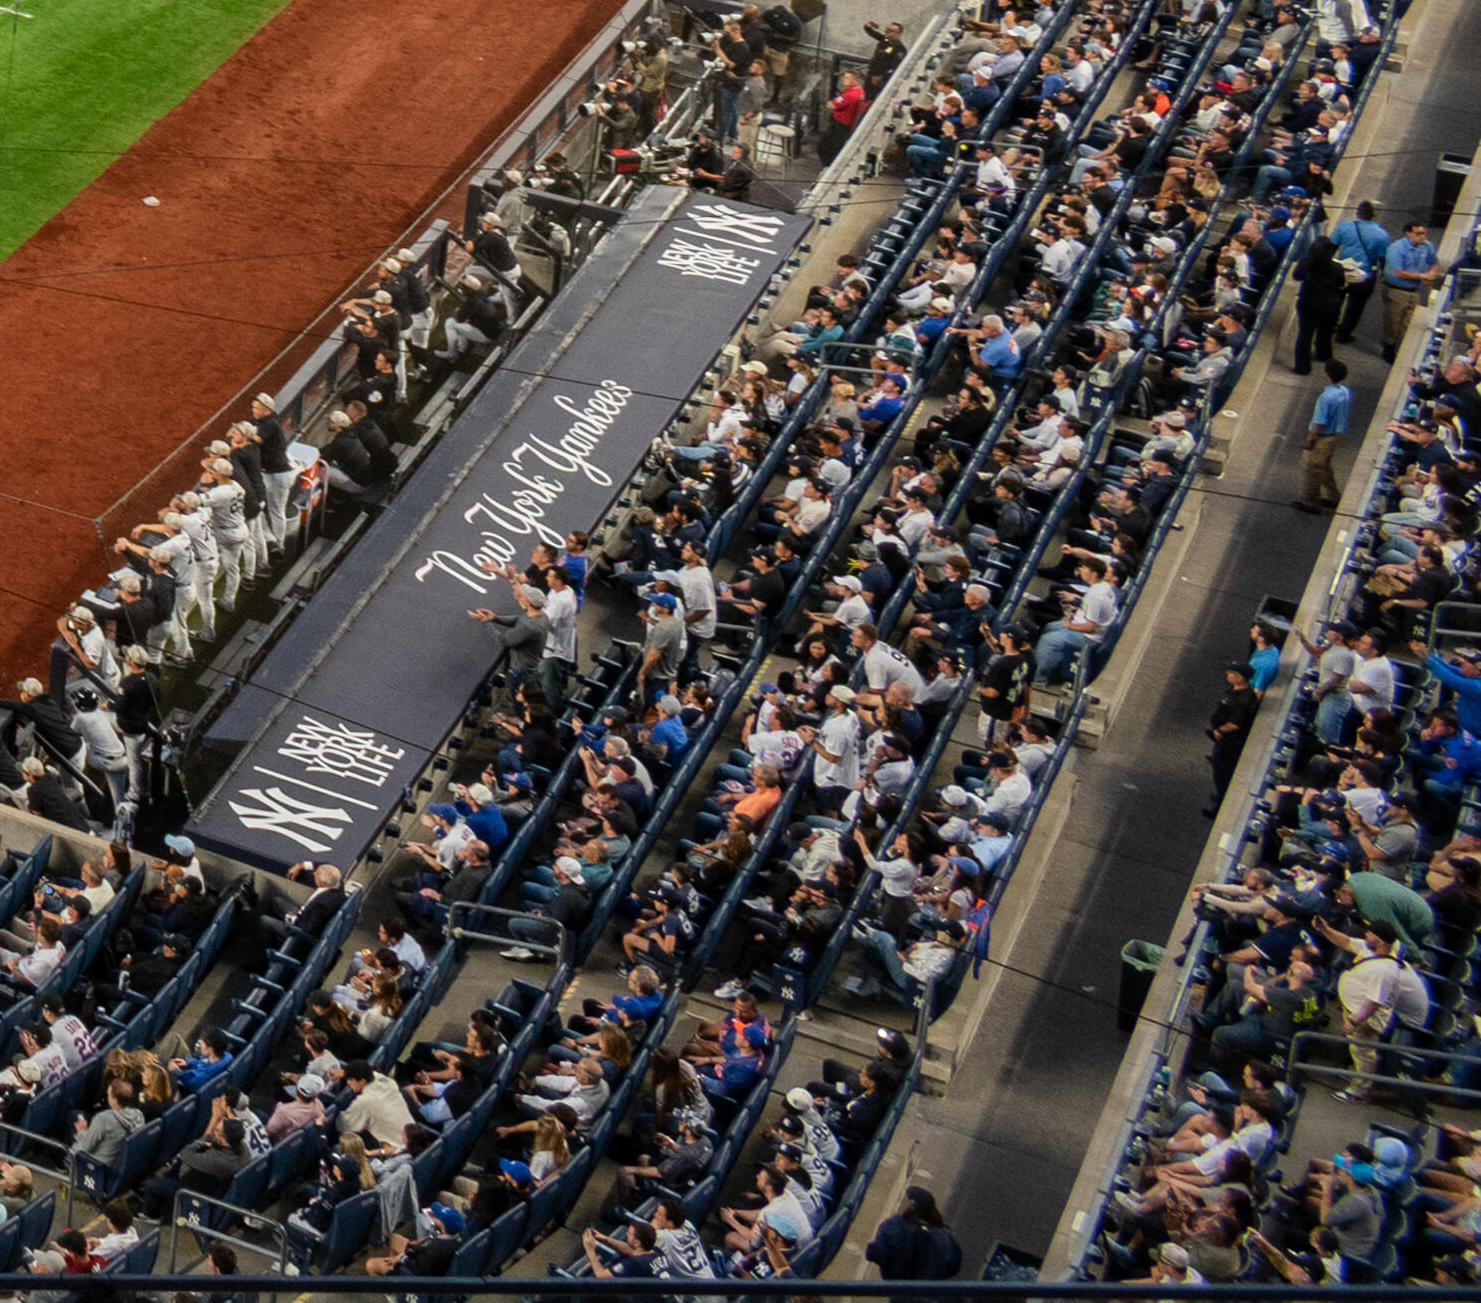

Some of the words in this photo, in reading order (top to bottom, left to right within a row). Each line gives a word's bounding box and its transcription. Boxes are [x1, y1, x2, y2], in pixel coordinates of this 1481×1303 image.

[512, 379, 633, 486] Yankees
[464, 462, 567, 549] York
[414, 531, 520, 596] New
